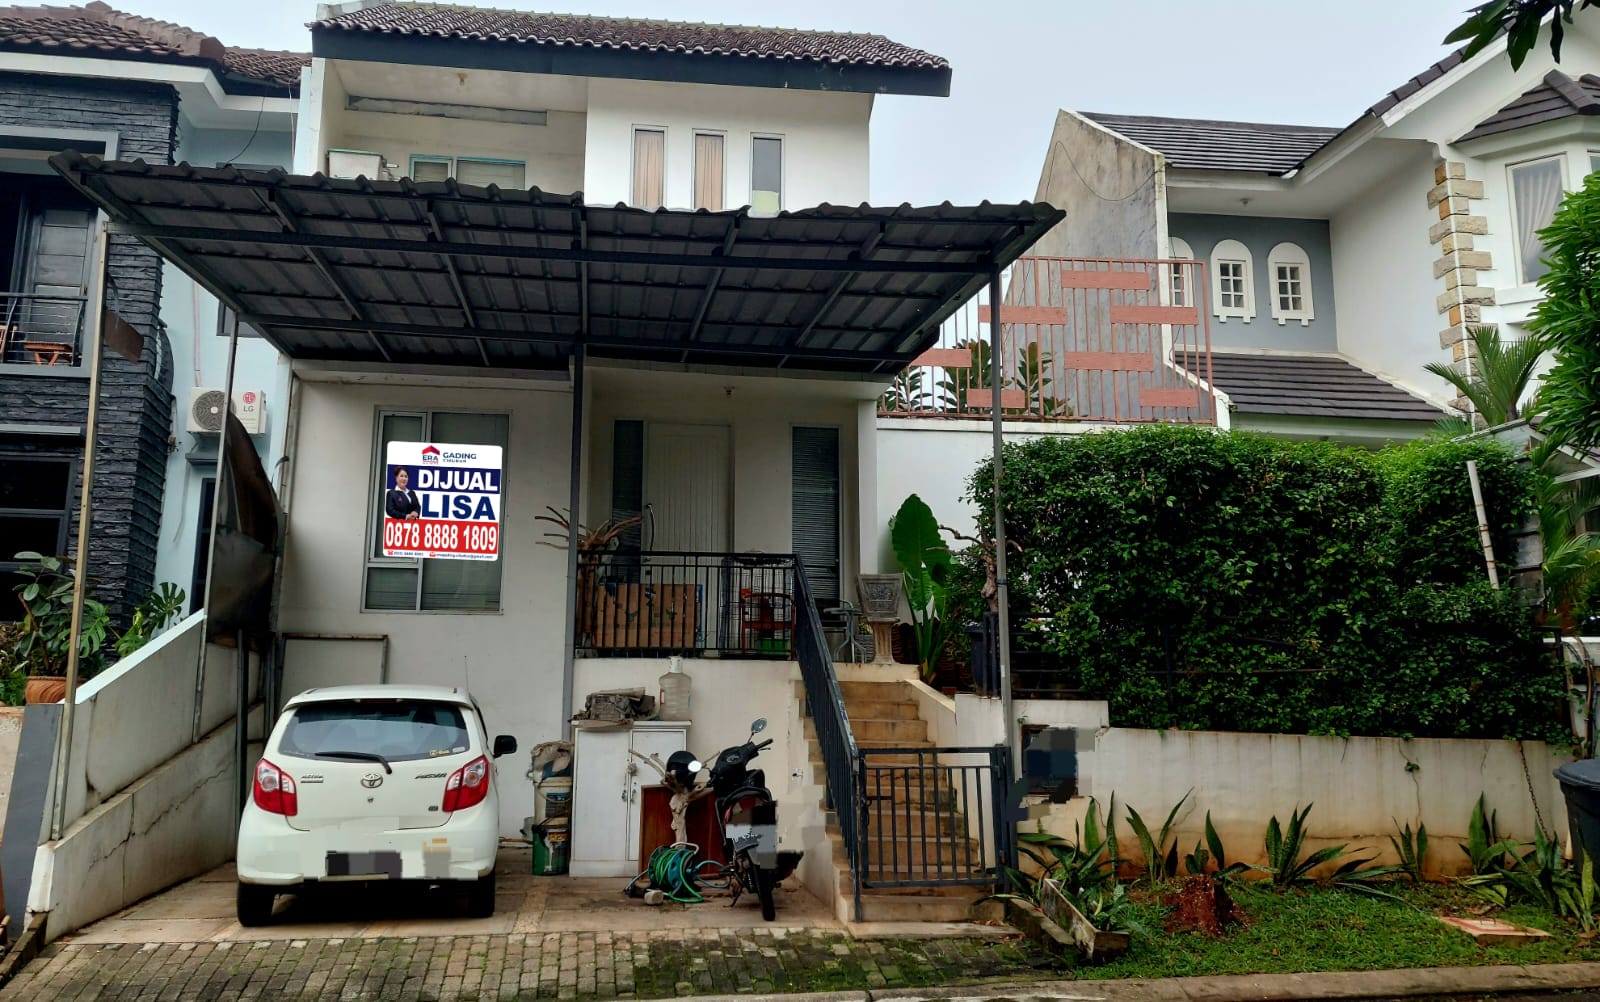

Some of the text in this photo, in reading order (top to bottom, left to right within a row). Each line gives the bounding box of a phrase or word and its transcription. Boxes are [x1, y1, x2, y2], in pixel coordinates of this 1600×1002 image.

[442, 452, 477, 460] GADING
[418, 469, 498, 492] DIJUAL
[421, 493, 496, 521] LISA
[385, 521, 497, 551] 0878 8888 1809
